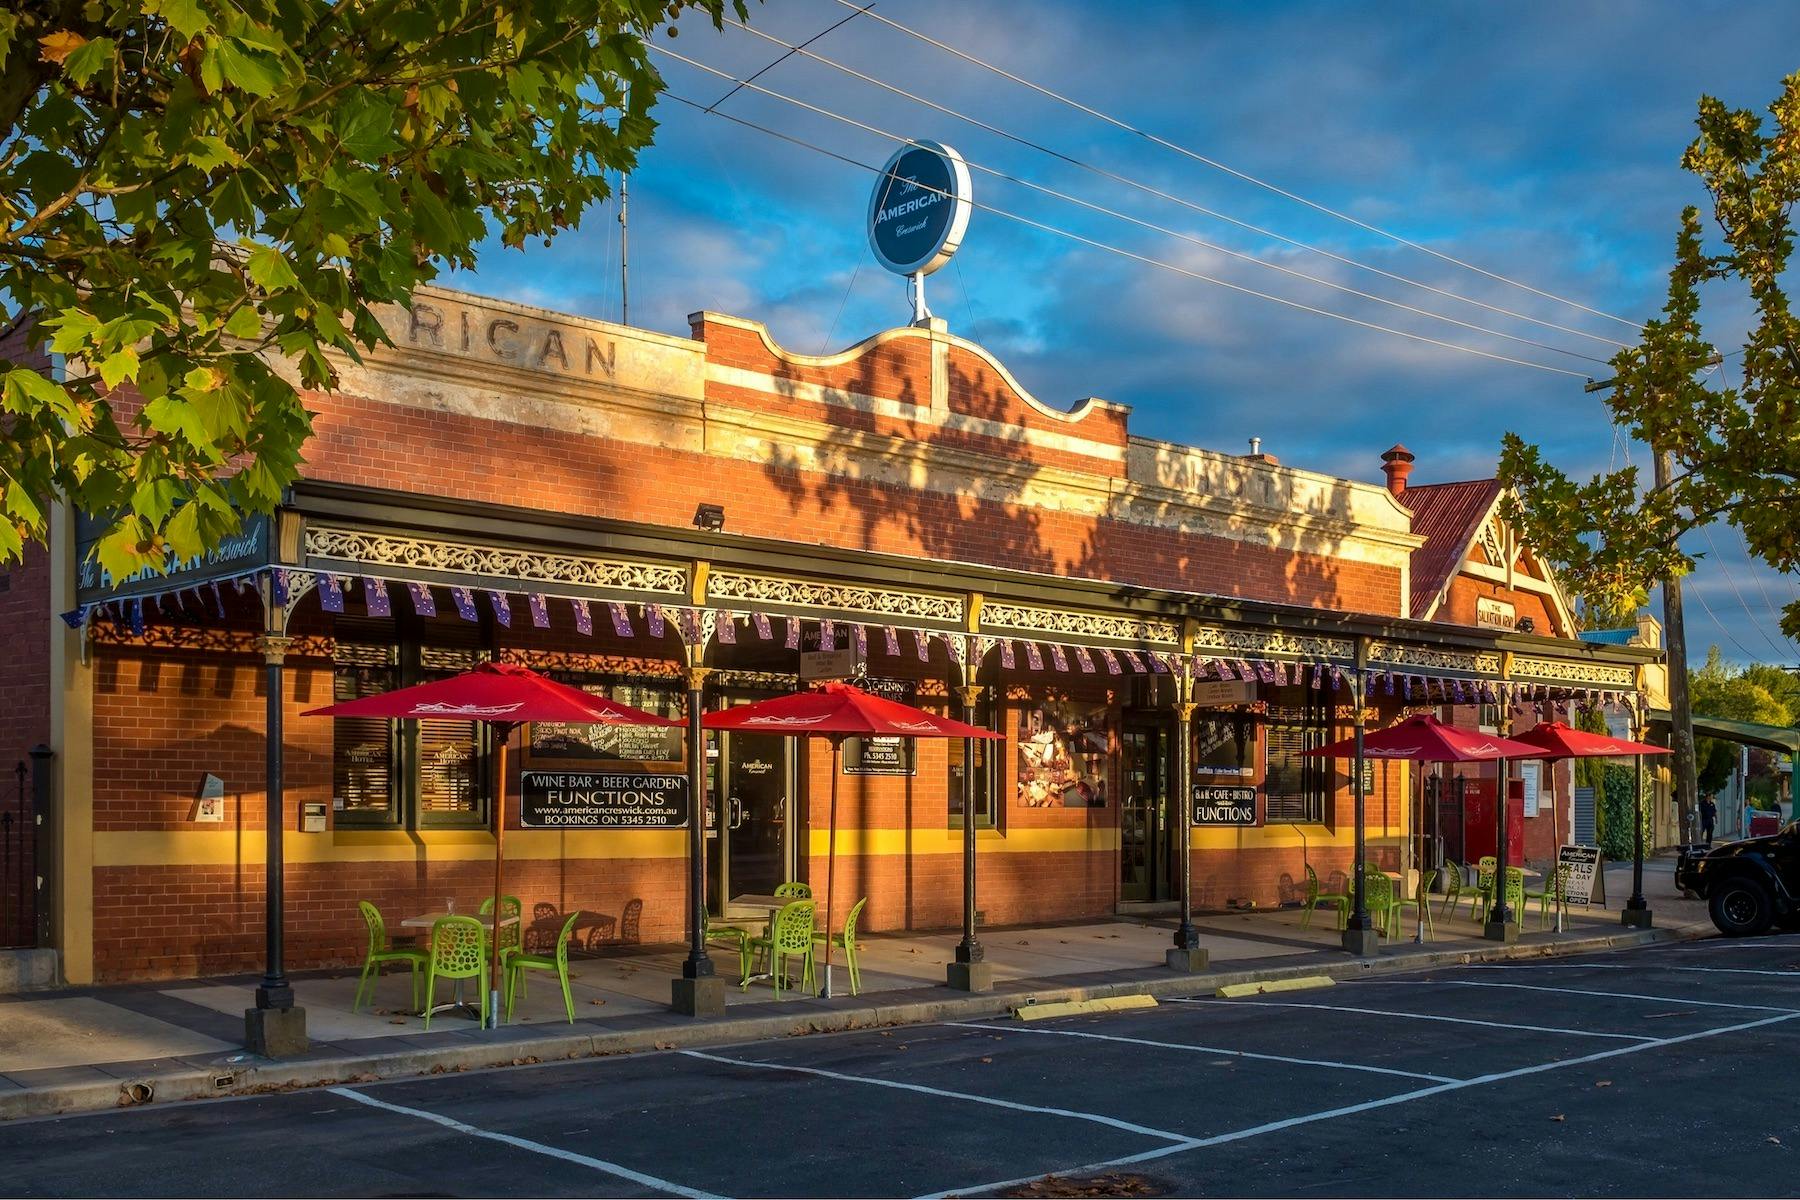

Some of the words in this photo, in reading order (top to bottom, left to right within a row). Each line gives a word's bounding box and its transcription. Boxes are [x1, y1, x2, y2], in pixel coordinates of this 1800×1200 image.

[900, 175, 919, 196] The
[878, 188, 947, 224] AMERICAN
[409, 304, 616, 379] RICAN
[1490, 604, 1501, 612] THE
[803, 628, 848, 640] AMEAN
[872, 680, 909, 693] OPENING
[741, 761, 773, 769] AMERICAN
[532, 775, 565, 788] WINE
[569, 776, 592, 788] BAR
[602, 776, 630, 789] BEER
[633, 777, 681, 790] GARDEN
[547, 790, 665, 806] FUNCTIONS
[1214, 789, 1229, 800] CAFE
[1232, 789, 1254, 801] BISTRO
[534, 806, 677, 815] www.americancreswick.com.au
[1196, 806, 1252, 821] FUNCTIONS
[545, 815, 598, 824] BOOKINGS
[601, 815, 618, 824] ON
[621, 815, 643, 824] 5345
[646, 815, 667, 824] 2510
[1561, 850, 1596, 859] AMERICAN
